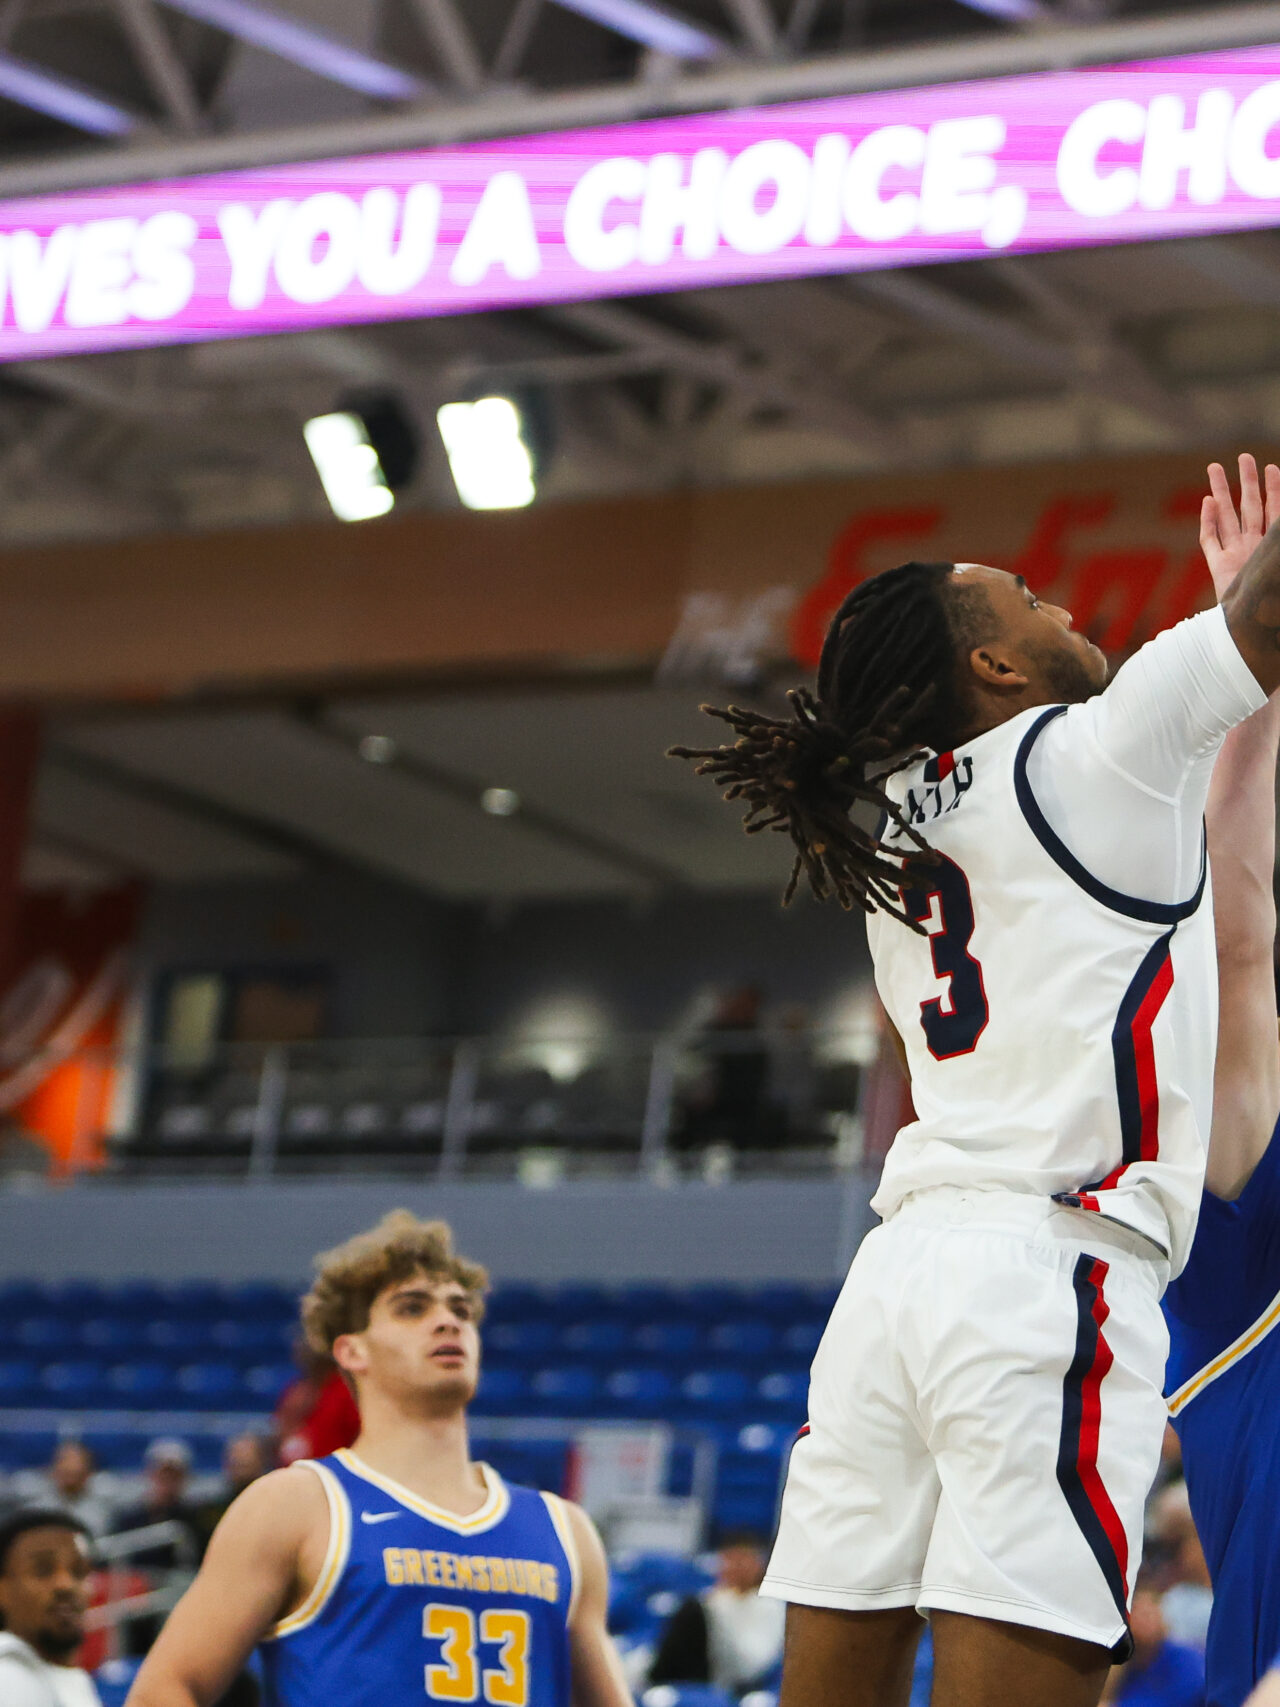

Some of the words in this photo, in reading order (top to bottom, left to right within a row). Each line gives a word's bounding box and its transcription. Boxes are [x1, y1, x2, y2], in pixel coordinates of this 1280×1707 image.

[217, 181, 443, 310] YOU
[450, 170, 541, 286] A
[563, 115, 1027, 272] CHOICE,
[899, 850, 990, 1061] 3
[382, 1546, 559, 1603] GREENSBURG
[422, 1602, 531, 1706] 33
